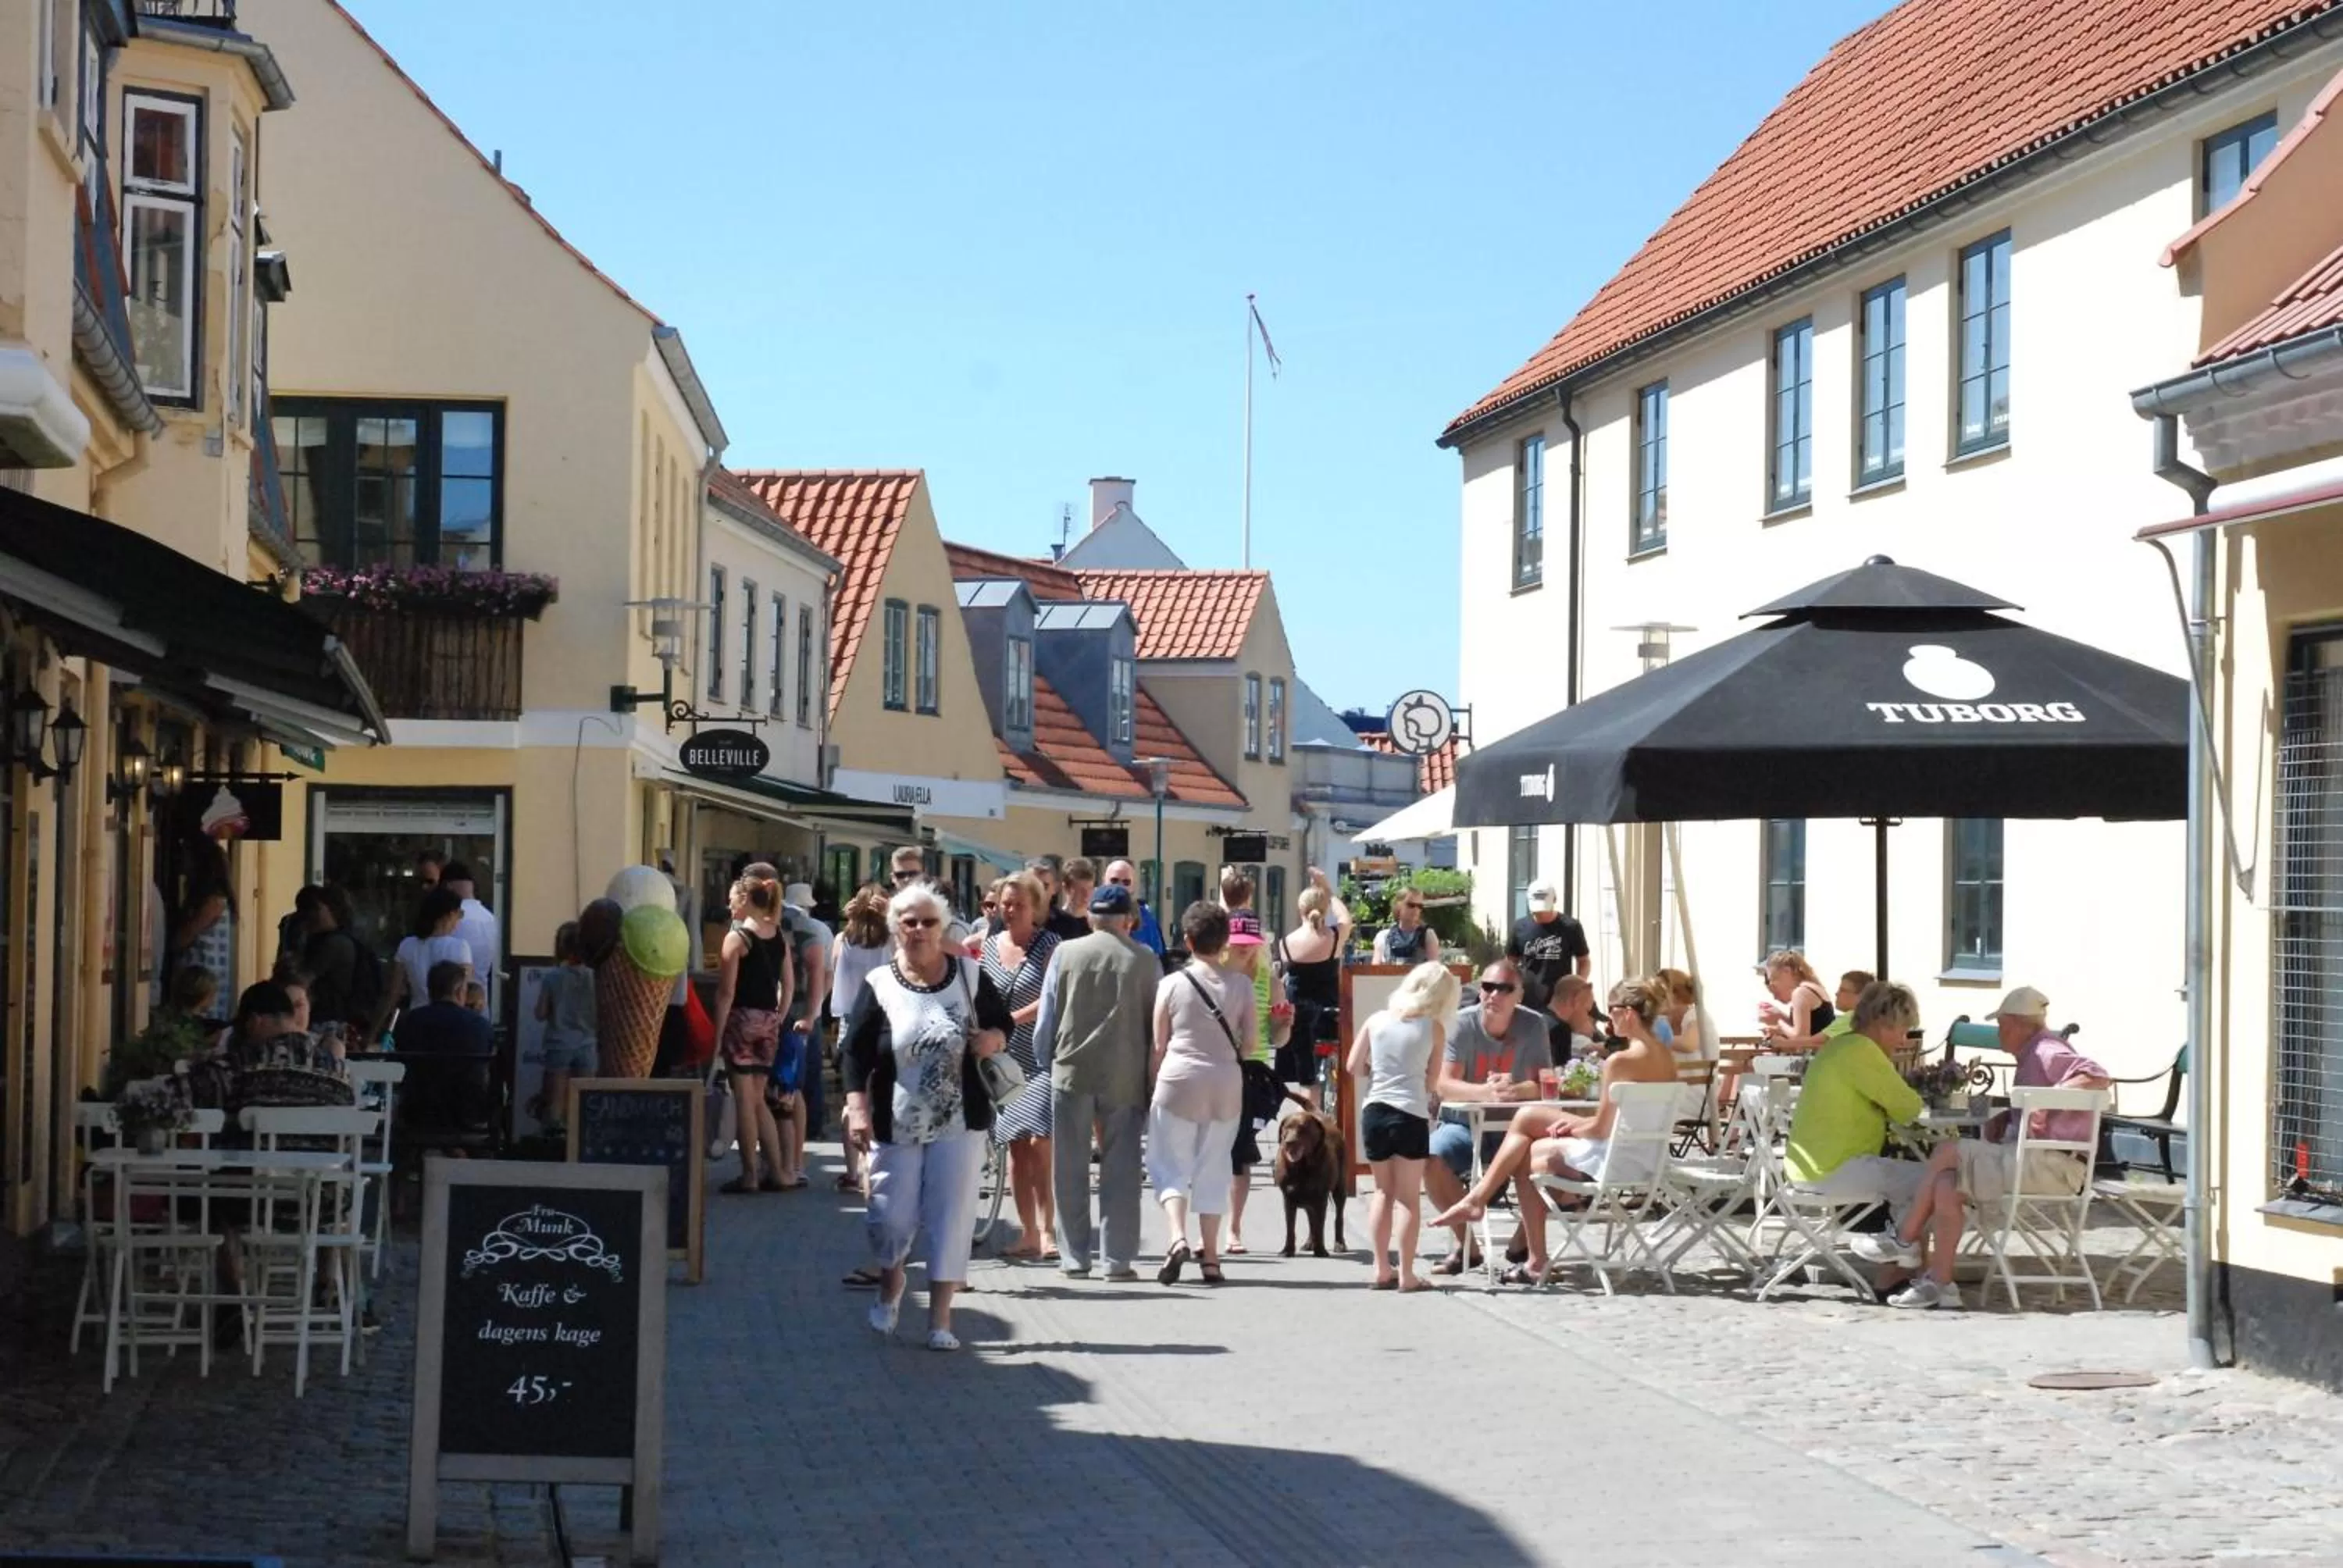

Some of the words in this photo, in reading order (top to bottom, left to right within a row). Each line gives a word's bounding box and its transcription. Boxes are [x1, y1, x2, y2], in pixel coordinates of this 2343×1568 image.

[1865, 702, 2087, 723] TUBORG
[688, 748, 761, 766] BELLEVILLE
[515, 1217, 574, 1235] Munk
[498, 1282, 557, 1308] Kaffe
[563, 1285, 587, 1303] &
[478, 1319, 547, 1345] dagens
[554, 1322, 601, 1348] kage
